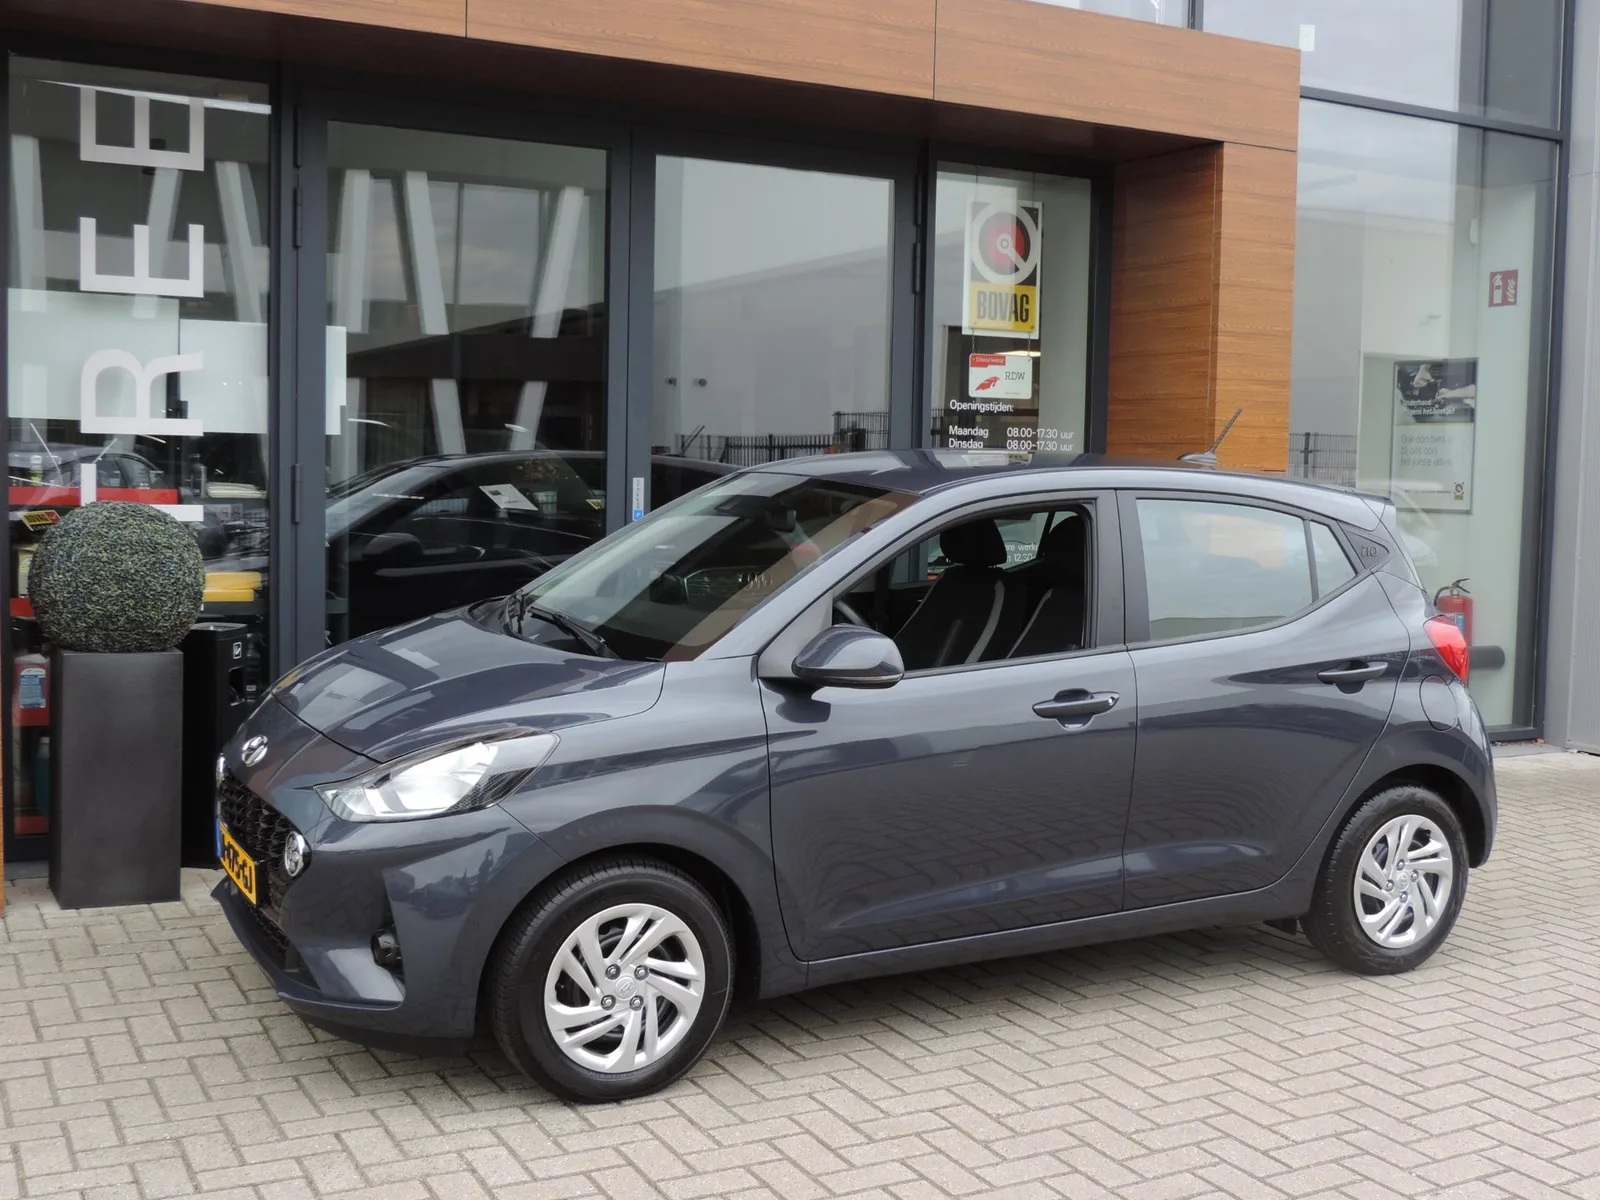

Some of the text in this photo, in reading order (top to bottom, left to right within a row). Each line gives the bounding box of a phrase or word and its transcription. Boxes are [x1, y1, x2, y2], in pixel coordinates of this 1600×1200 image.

[976, 290, 1030, 323] BOVAG
[1005, 371, 1026, 381] RDW
[949, 399, 1015, 414] Openingstijden:
[948, 425, 1074, 439] Maandag 08.00-17.30 uur
[948, 438, 1074, 451] Dinsdag 08.00-17.30 uur
